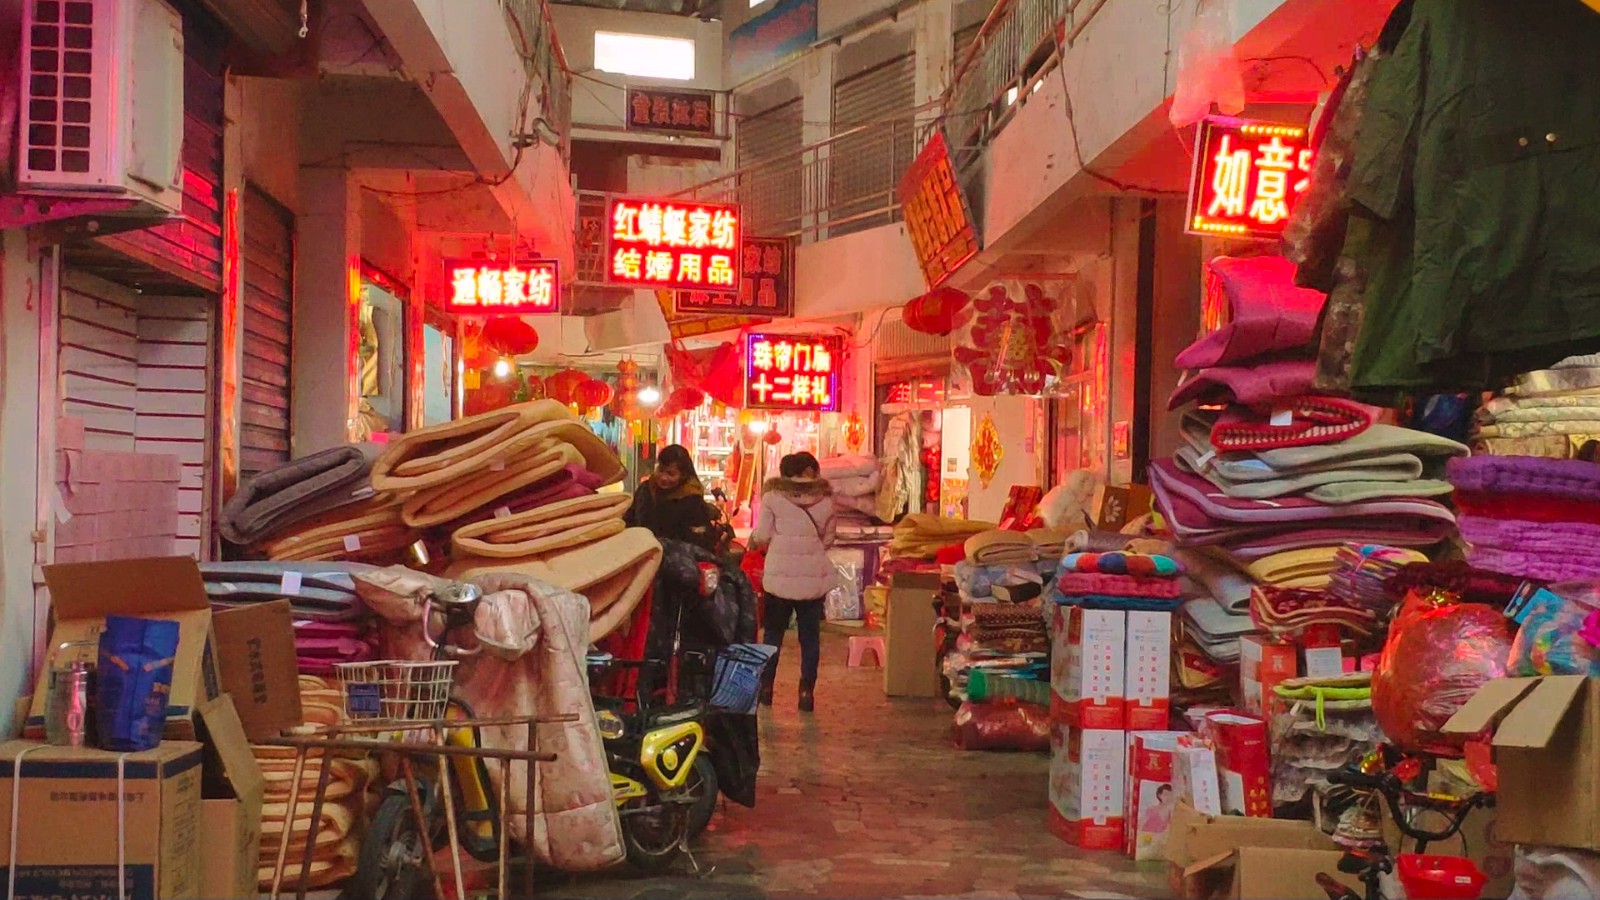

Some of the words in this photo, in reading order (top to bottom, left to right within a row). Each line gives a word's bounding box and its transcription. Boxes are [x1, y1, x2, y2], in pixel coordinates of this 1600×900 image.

[1207, 134, 1313, 224] 如意
[612, 203, 736, 249] 红蜻蜓家纺
[613, 248, 734, 285] 结婚用品
[752, 373, 830, 405] 十二样礼
